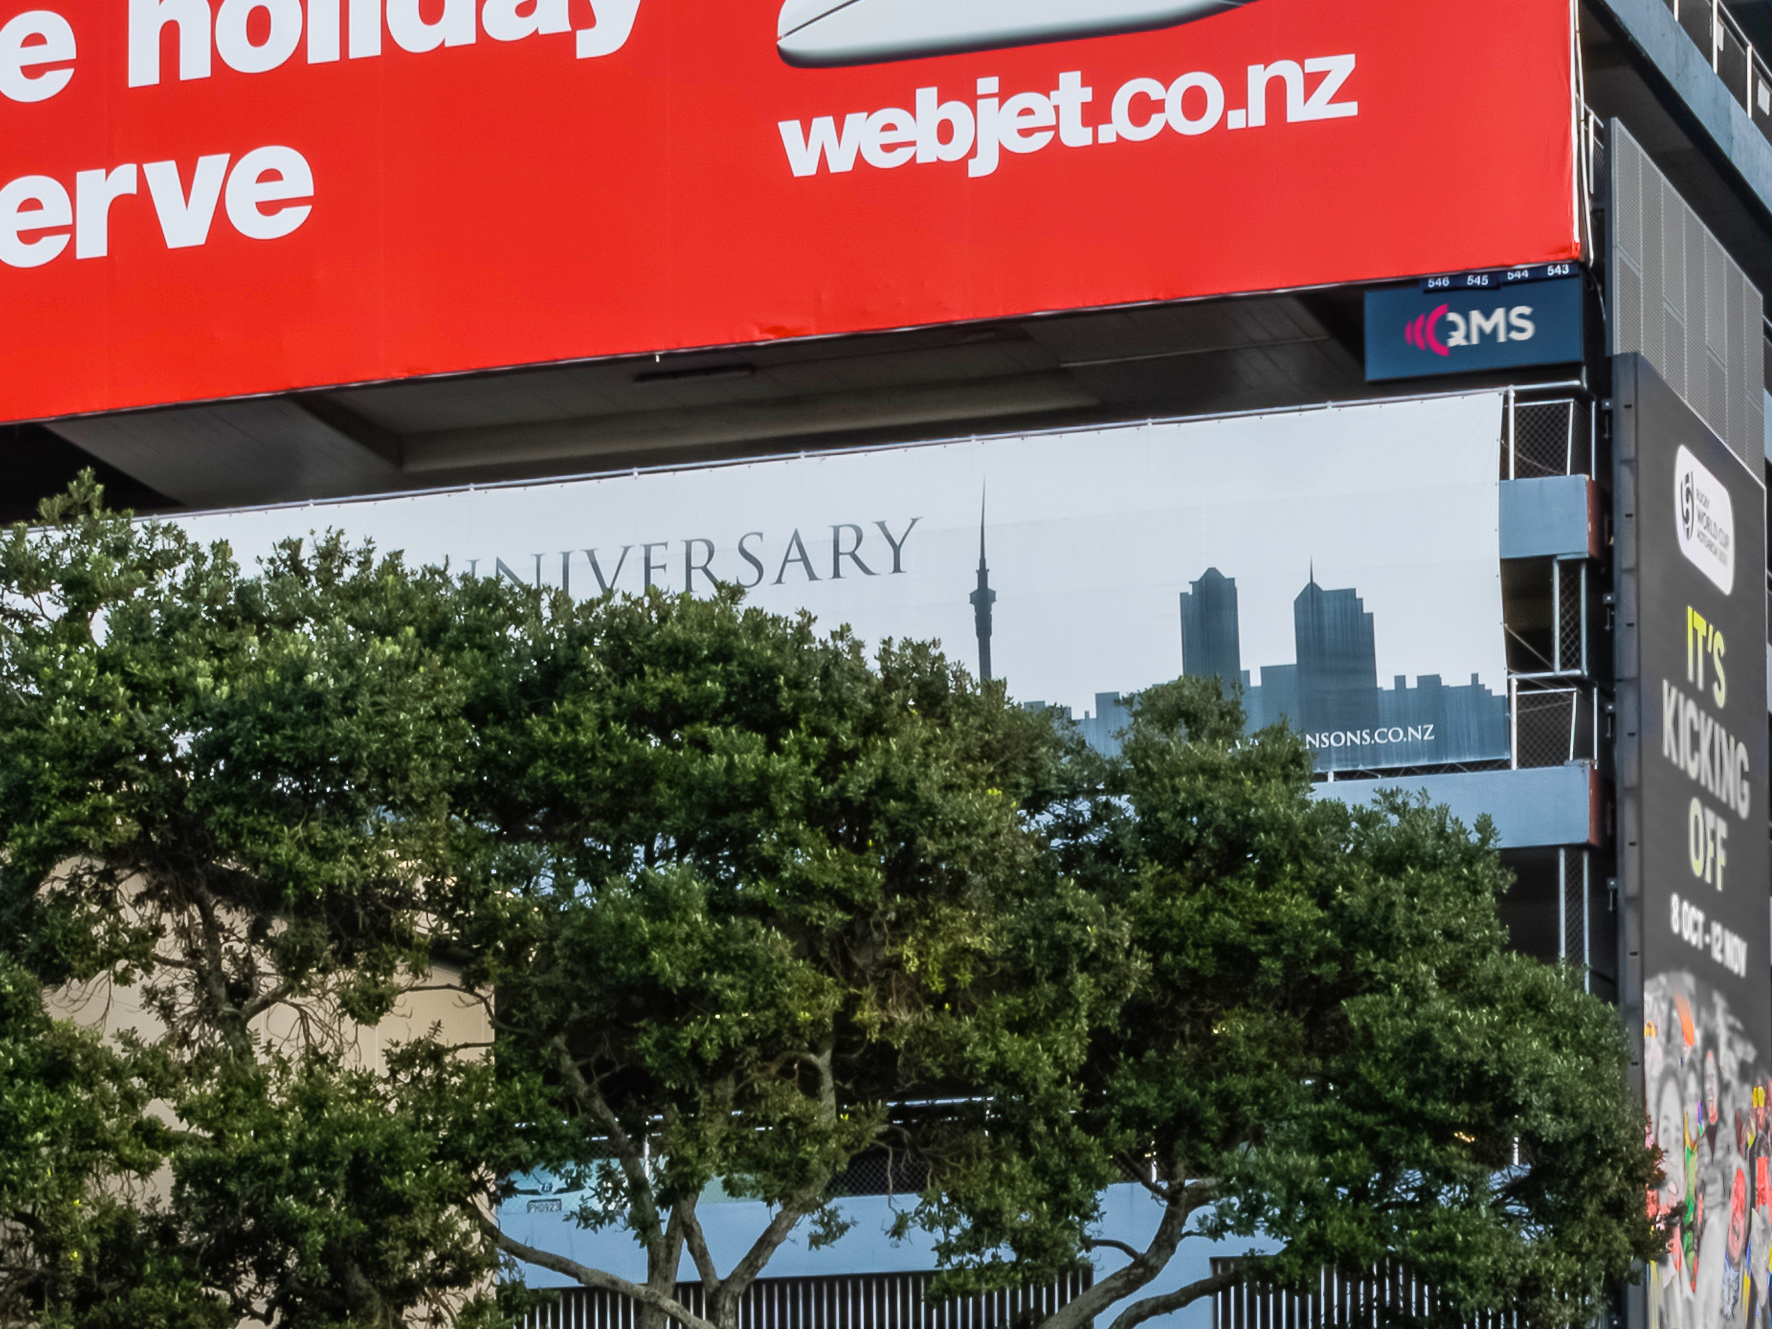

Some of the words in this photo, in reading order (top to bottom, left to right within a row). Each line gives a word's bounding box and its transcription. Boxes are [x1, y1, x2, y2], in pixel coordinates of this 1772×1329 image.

[777, 53, 1359, 178] webjet.co.nz
[1427, 276, 1450, 288] 546
[1466, 274, 1489, 286] 545
[1507, 269, 1529, 281] 544
[1547, 263, 1570, 277] 543
[1426, 304, 1535, 356] QMS
[463, 517, 924, 598] NIVERSARY
[1687, 605, 1727, 708] IT'S
[1305, 724, 1436, 750] NSONS.CO.NZ
[1662, 679, 1751, 820] KICKING
[1689, 797, 1727, 892] OFF
[1671, 892, 1681, 936] 8
[1681, 900, 1706, 951] OCT
[1723, 930, 1748, 978] NOV
